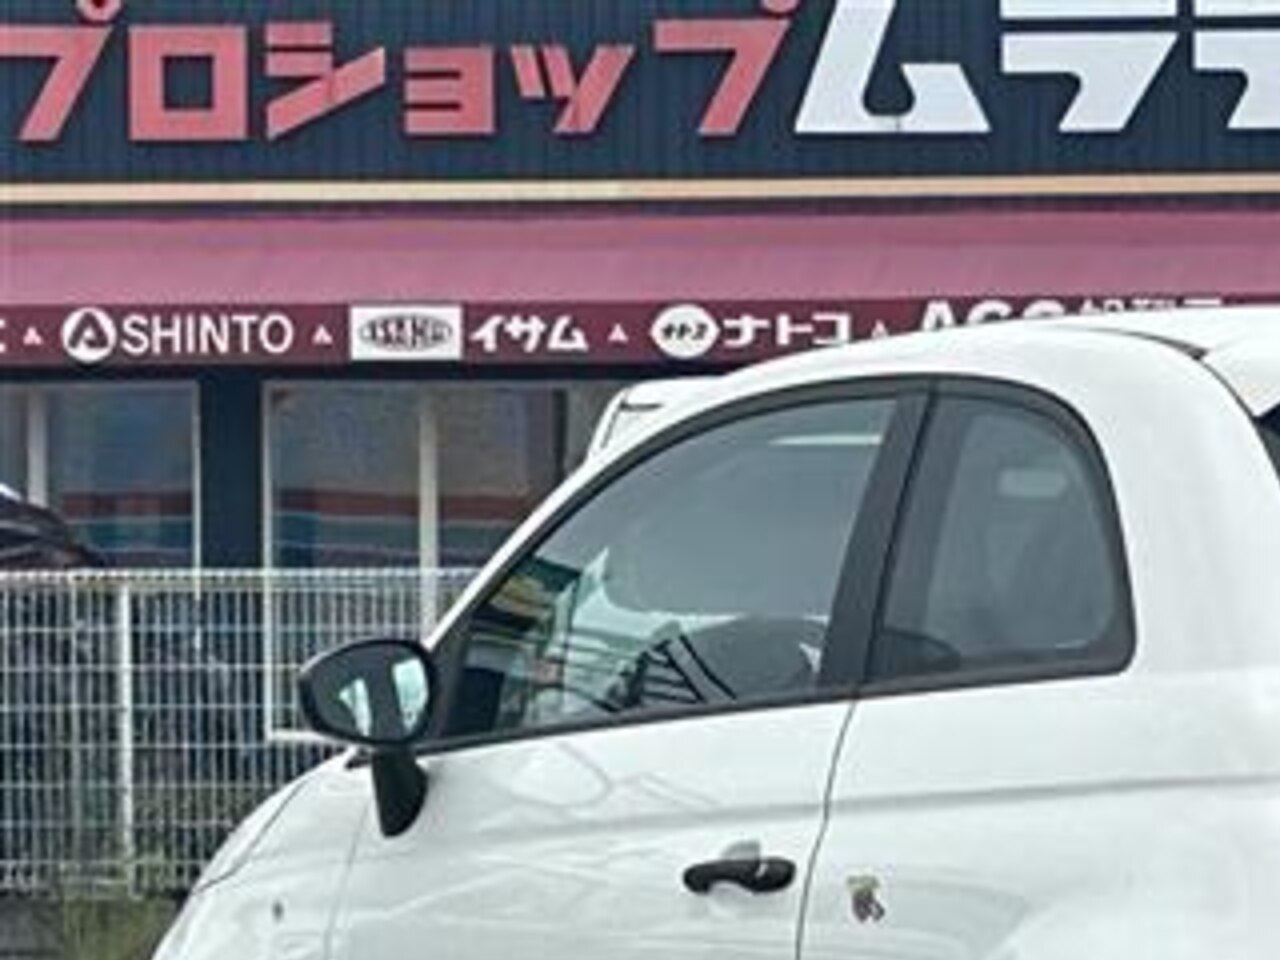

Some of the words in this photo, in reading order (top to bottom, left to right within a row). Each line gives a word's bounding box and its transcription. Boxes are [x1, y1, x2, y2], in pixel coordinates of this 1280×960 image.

[121, 313, 294, 354] SHINTO
[470, 314, 589, 352] イサム
[723, 312, 852, 347] ナトコ
